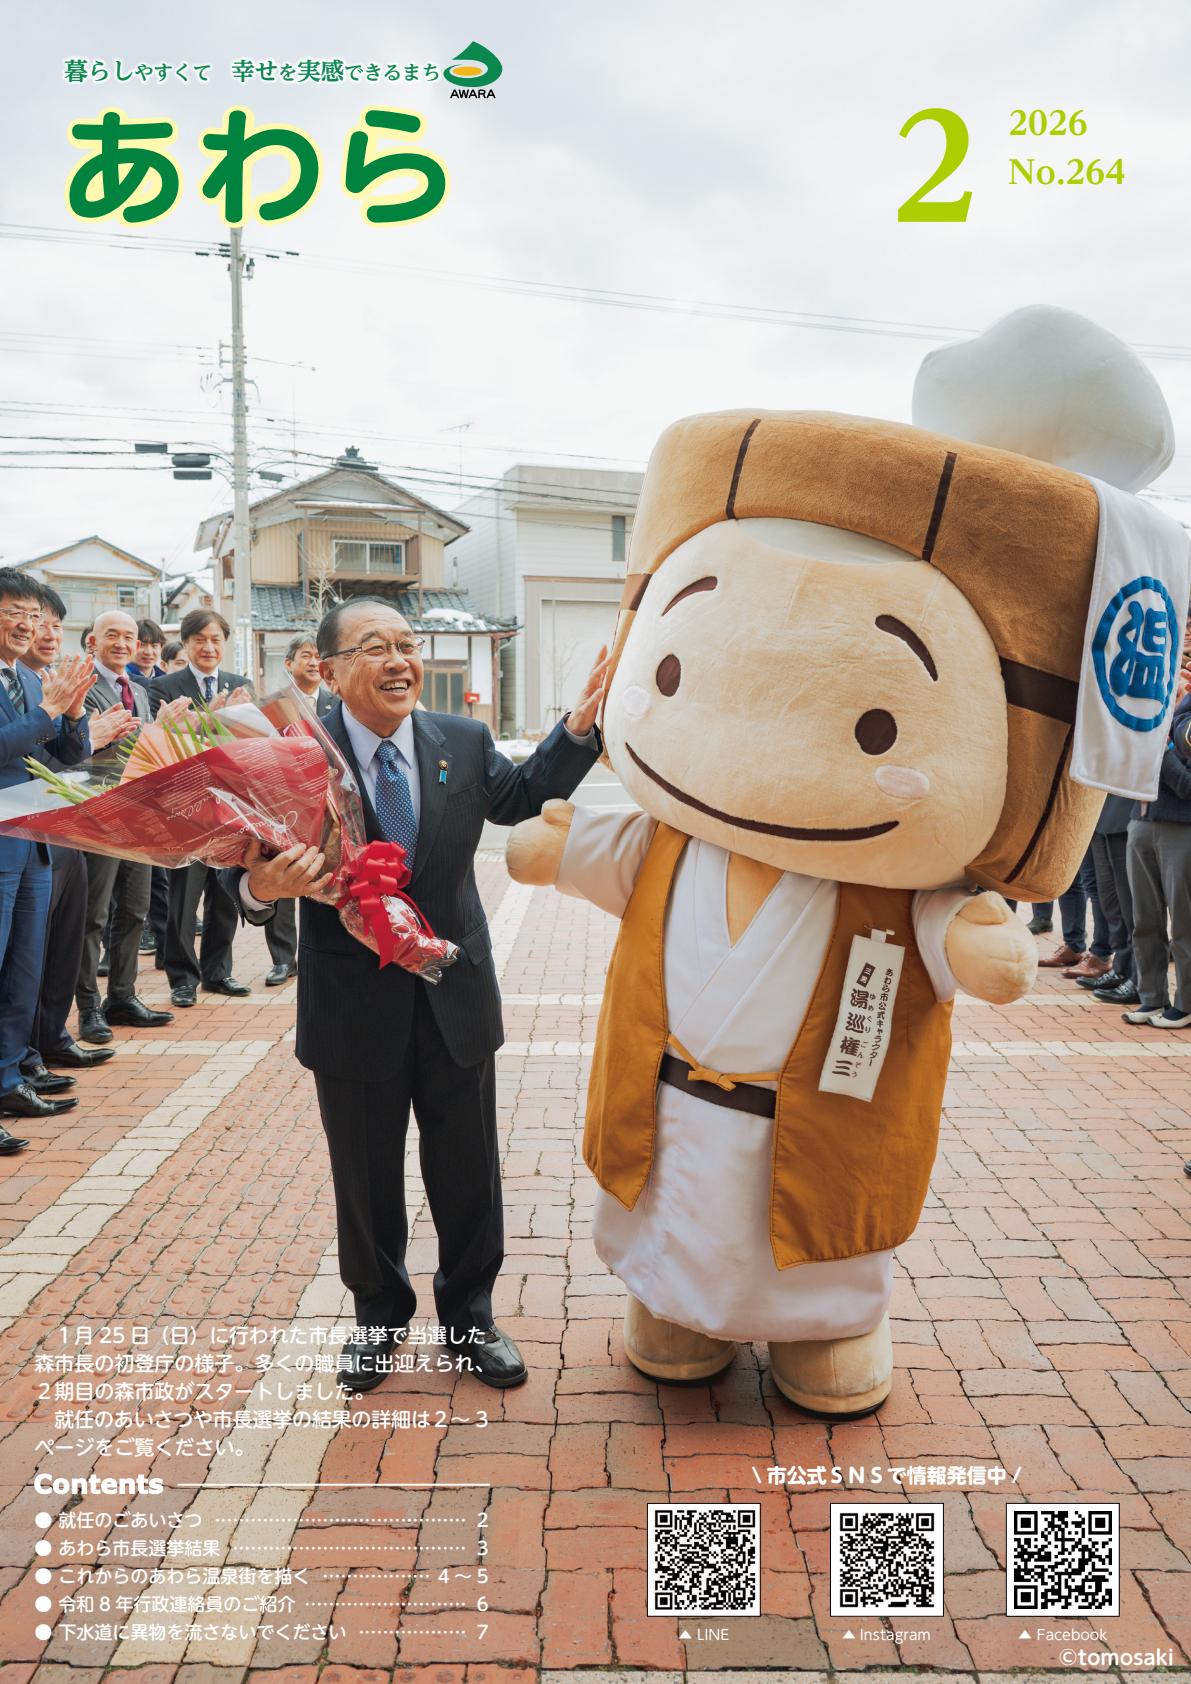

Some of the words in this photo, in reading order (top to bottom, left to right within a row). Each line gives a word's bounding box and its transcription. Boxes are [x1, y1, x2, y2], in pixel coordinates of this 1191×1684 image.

[869, 968, 893, 1067] あわら市公式キャラクター
